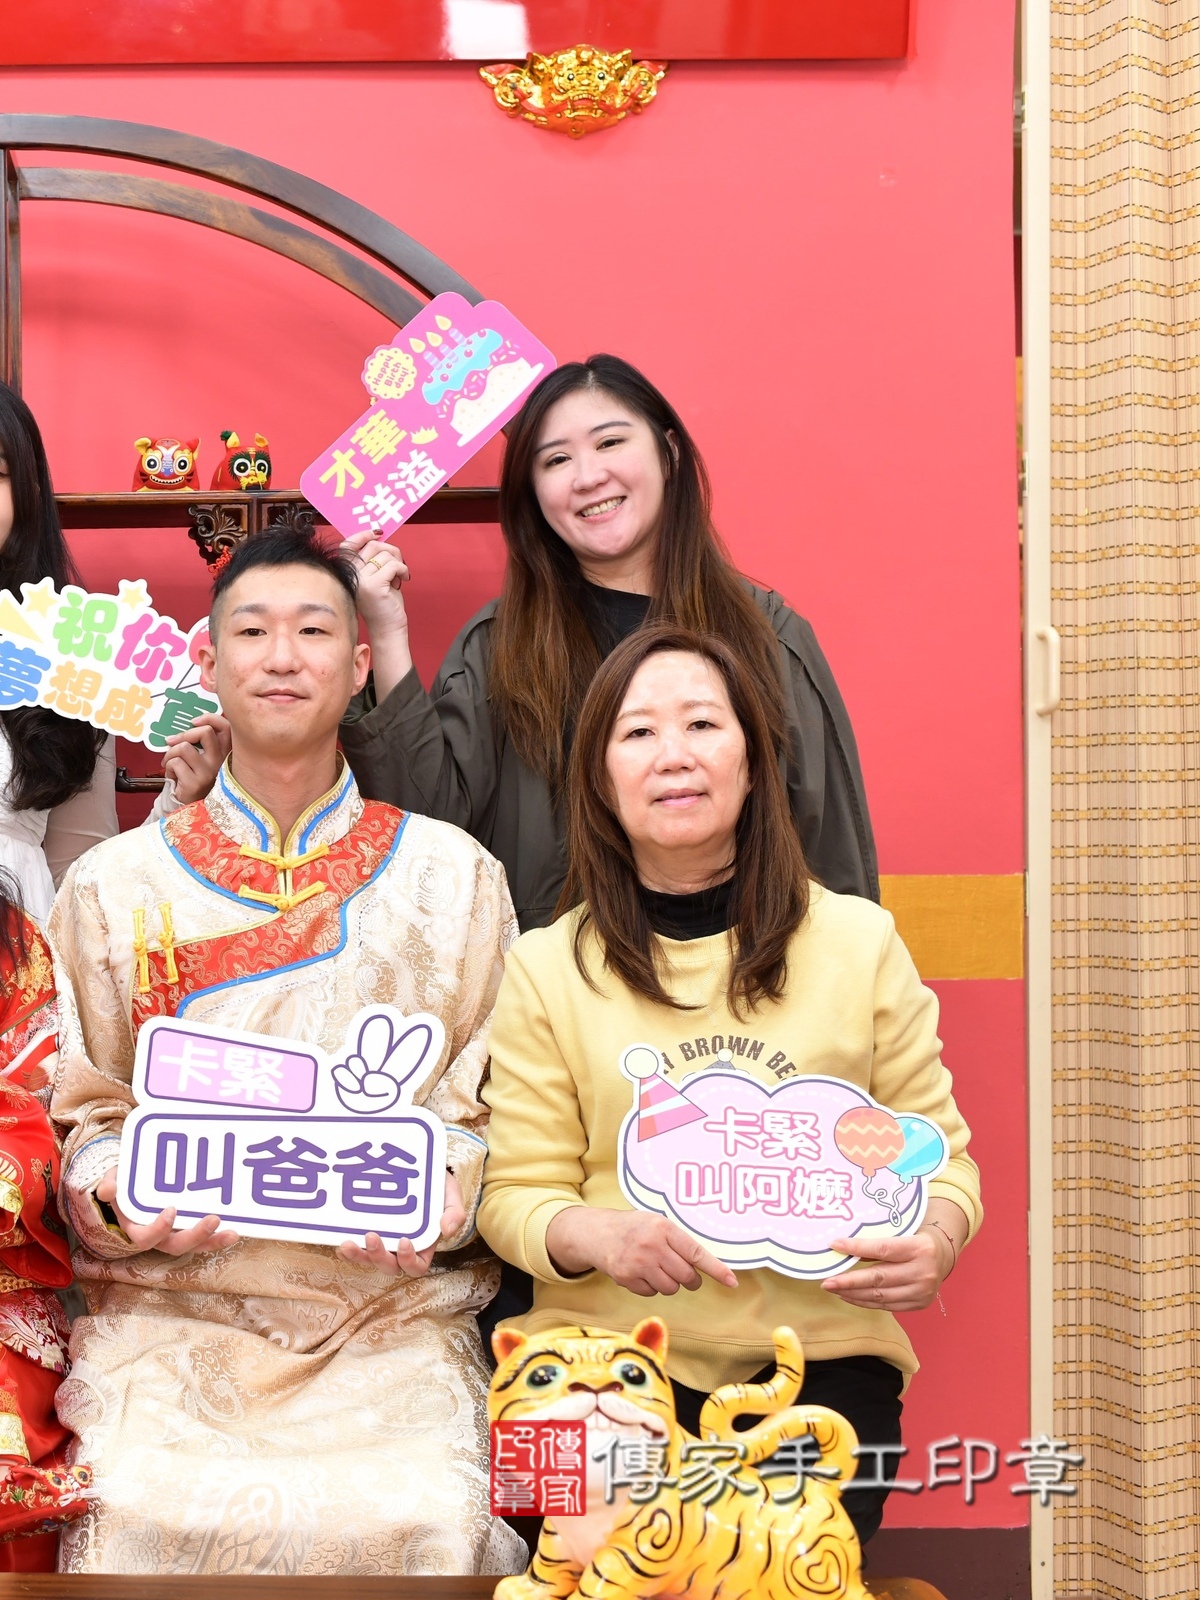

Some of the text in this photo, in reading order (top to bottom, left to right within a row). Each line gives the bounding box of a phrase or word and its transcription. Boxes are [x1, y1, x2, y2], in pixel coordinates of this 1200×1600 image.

[372, 355, 394, 386] Happy
[319, 409, 407, 497] 才華
[352, 449, 447, 530] 洋溢
[53, 592, 188, 683] 祝你
[158, 1040, 284, 1104] 卡緊
[679, 1035, 765, 1062] BROWN
[703, 1105, 822, 1161] 卡緊
[154, 1131, 420, 1215] 叫爸爸
